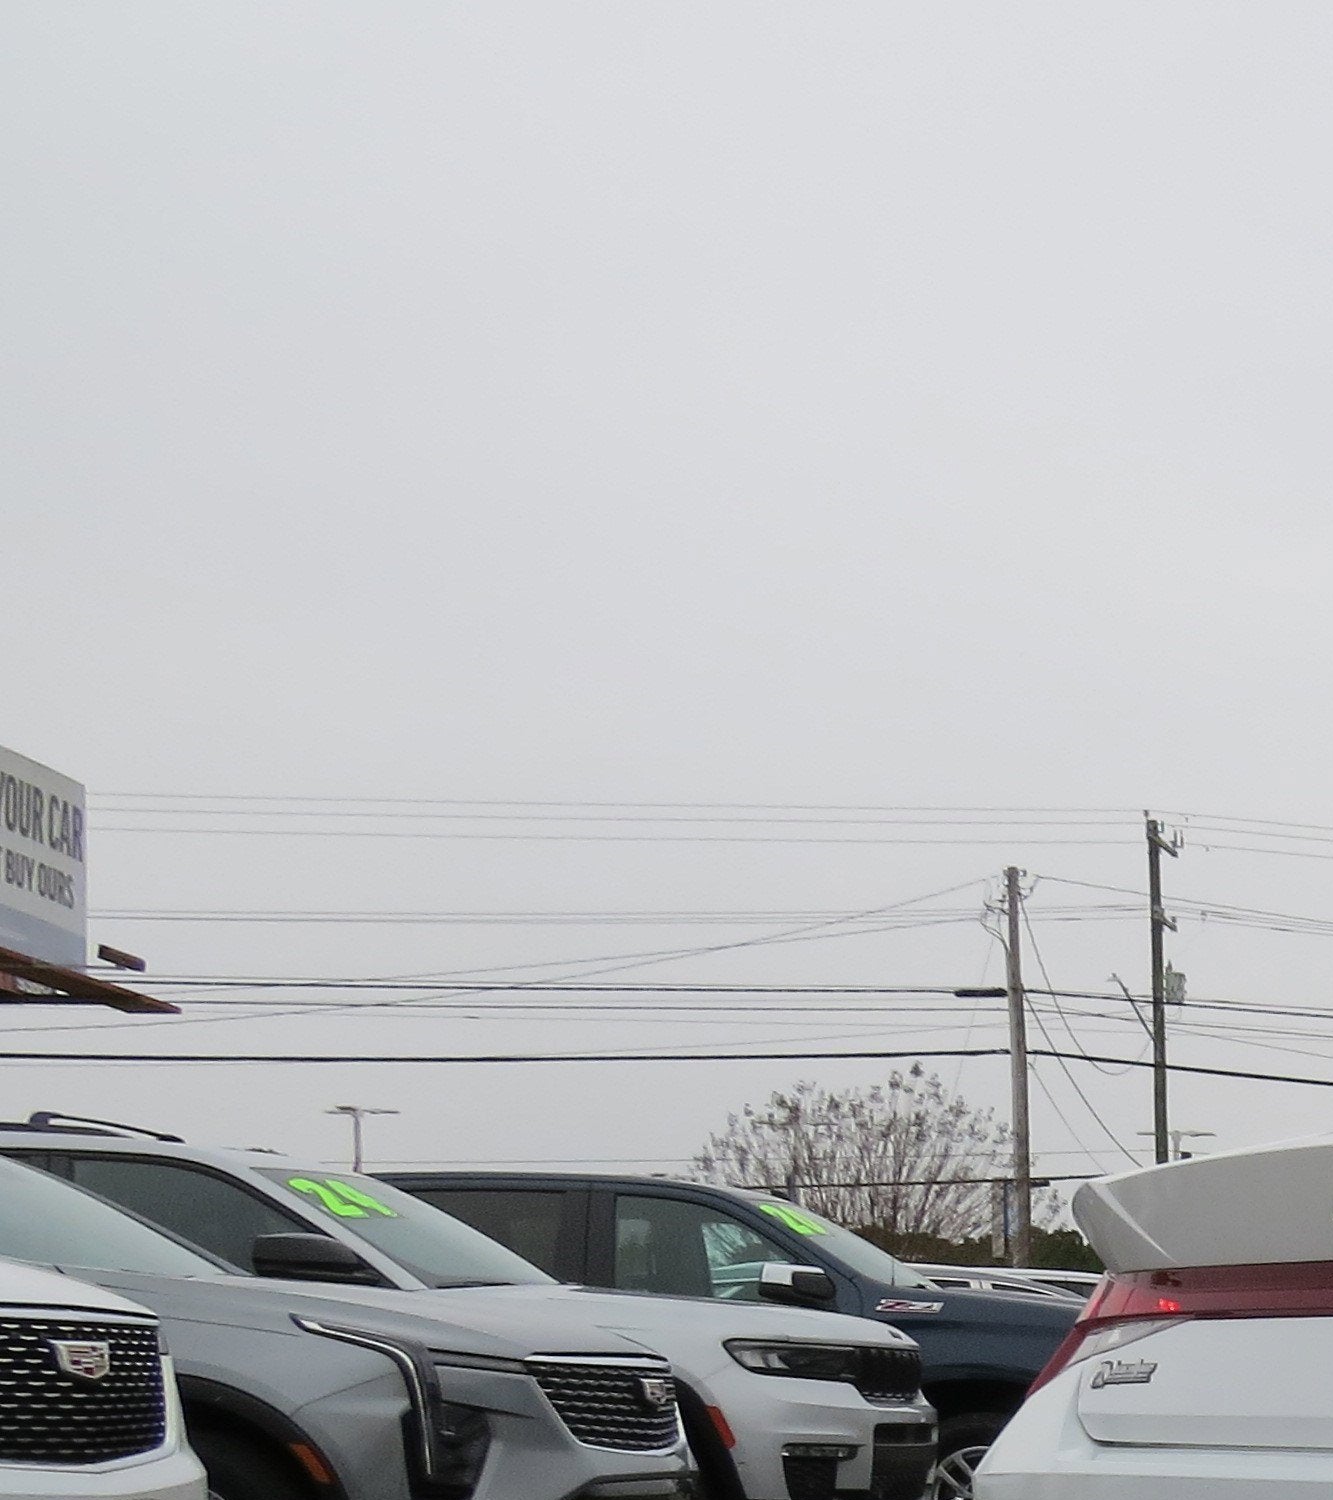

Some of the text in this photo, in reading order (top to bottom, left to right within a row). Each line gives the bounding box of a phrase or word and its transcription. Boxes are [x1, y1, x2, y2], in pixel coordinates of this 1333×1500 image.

[48, 794, 83, 862] CAR
[6, 849, 74, 909] BUY OURS
